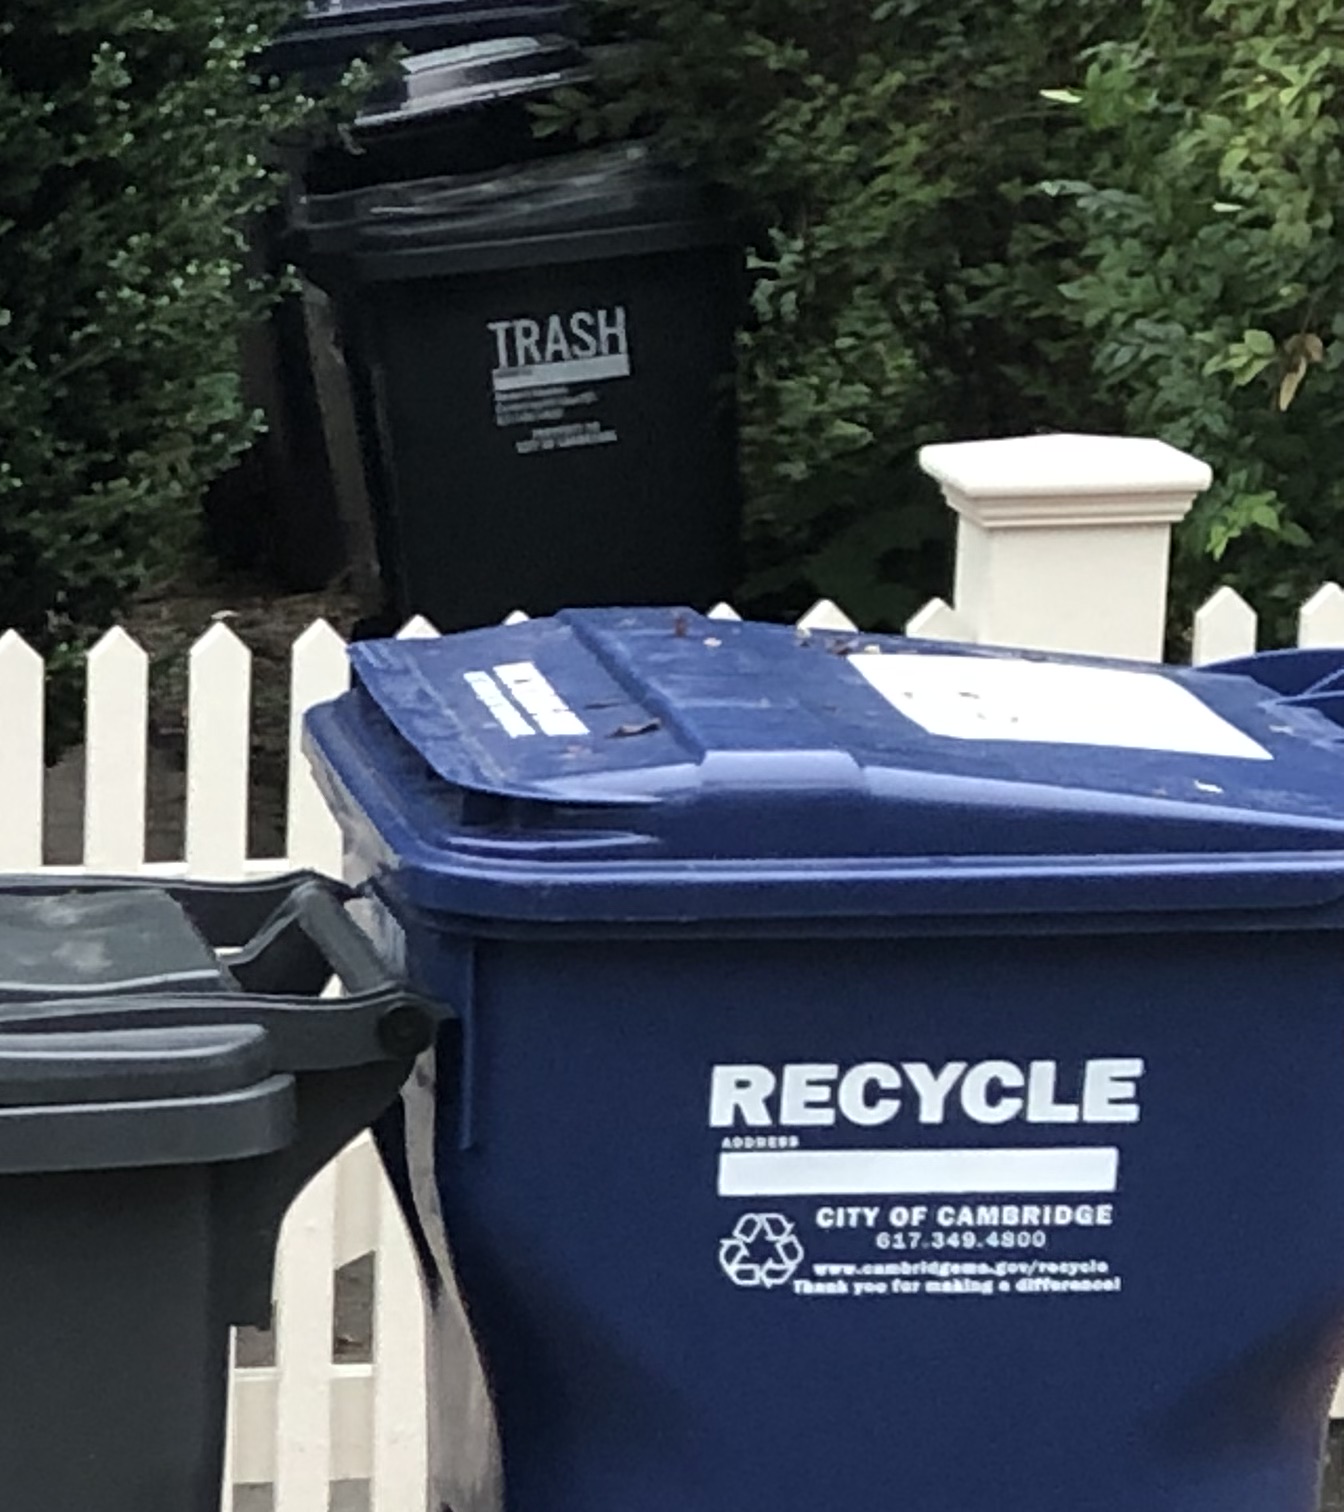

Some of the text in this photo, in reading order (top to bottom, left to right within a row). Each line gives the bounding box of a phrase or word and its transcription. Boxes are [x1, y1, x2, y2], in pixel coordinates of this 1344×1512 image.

[487, 306, 628, 368] TRASH
[709, 1058, 1144, 1127] RECYCLE
[721, 1135, 799, 1149] ADDRESS
[815, 1203, 1113, 1227] CITY OF CAMBRIDGE
[876, 1230, 1046, 1249] 617.349.4800
[793, 1279, 848, 1293] Thank
[853, 1280, 887, 1295] you
[891, 1278, 921, 1293] for
[925, 1278, 993, 1294] making
[998, 1280, 1010, 1292] a
